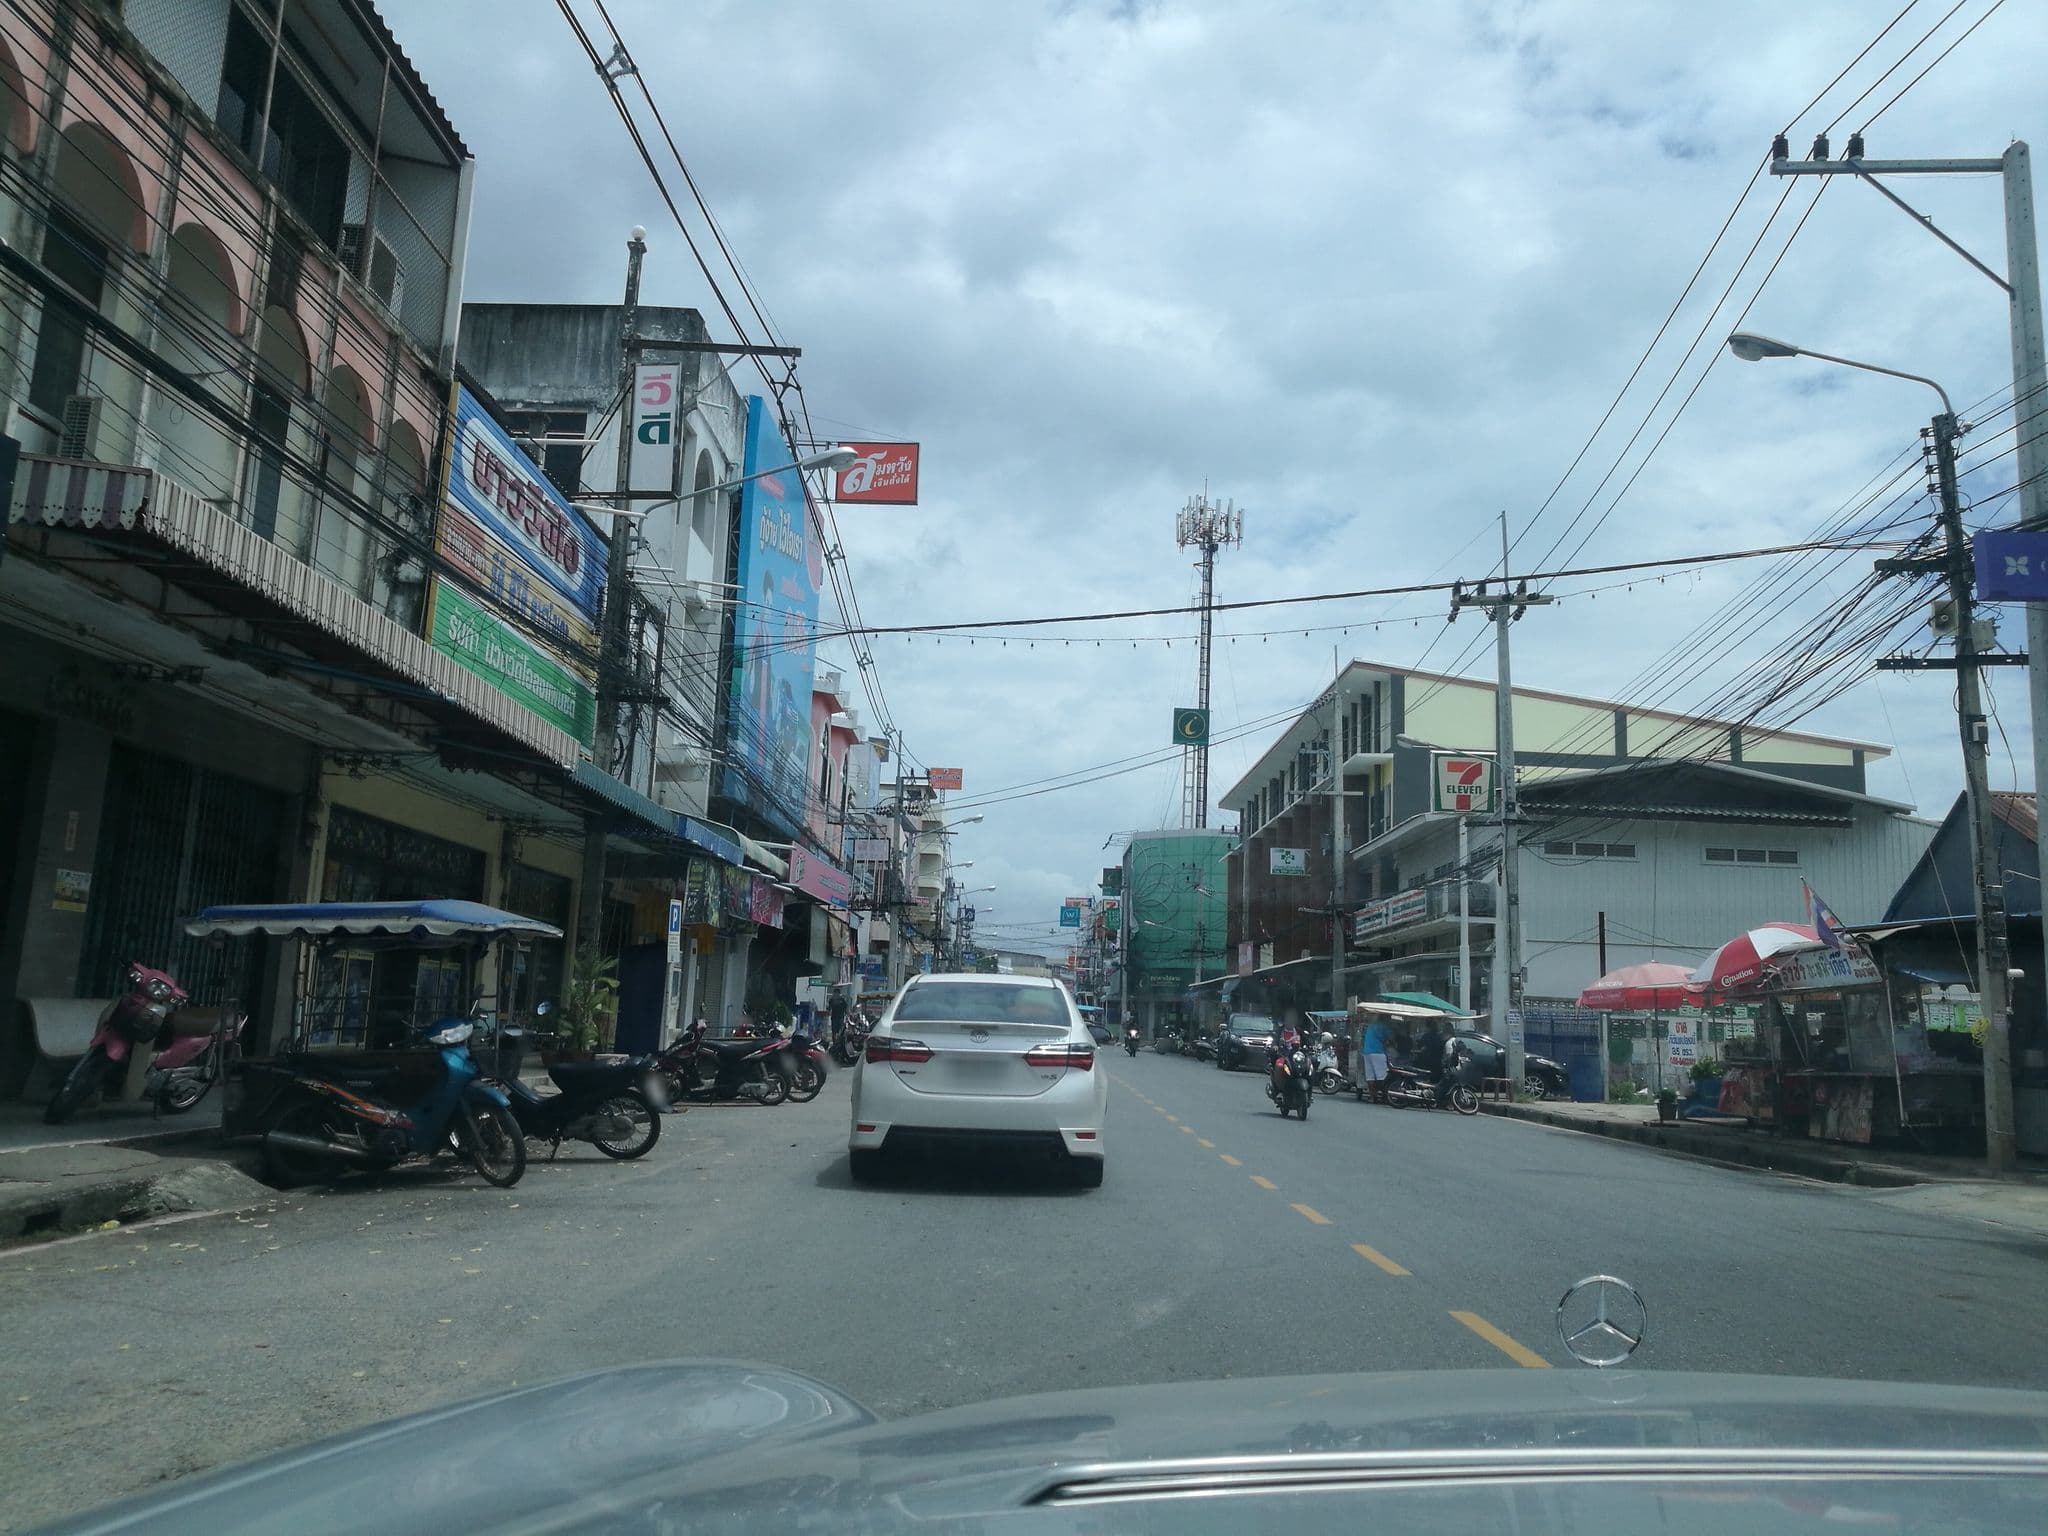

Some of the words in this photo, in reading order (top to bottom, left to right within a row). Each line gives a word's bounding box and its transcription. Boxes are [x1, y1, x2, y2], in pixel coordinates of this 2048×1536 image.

[842, 450, 913, 495] สมหวัง
[1446, 760, 1483, 810] 7
[1721, 968, 1754, 987] Carnation
